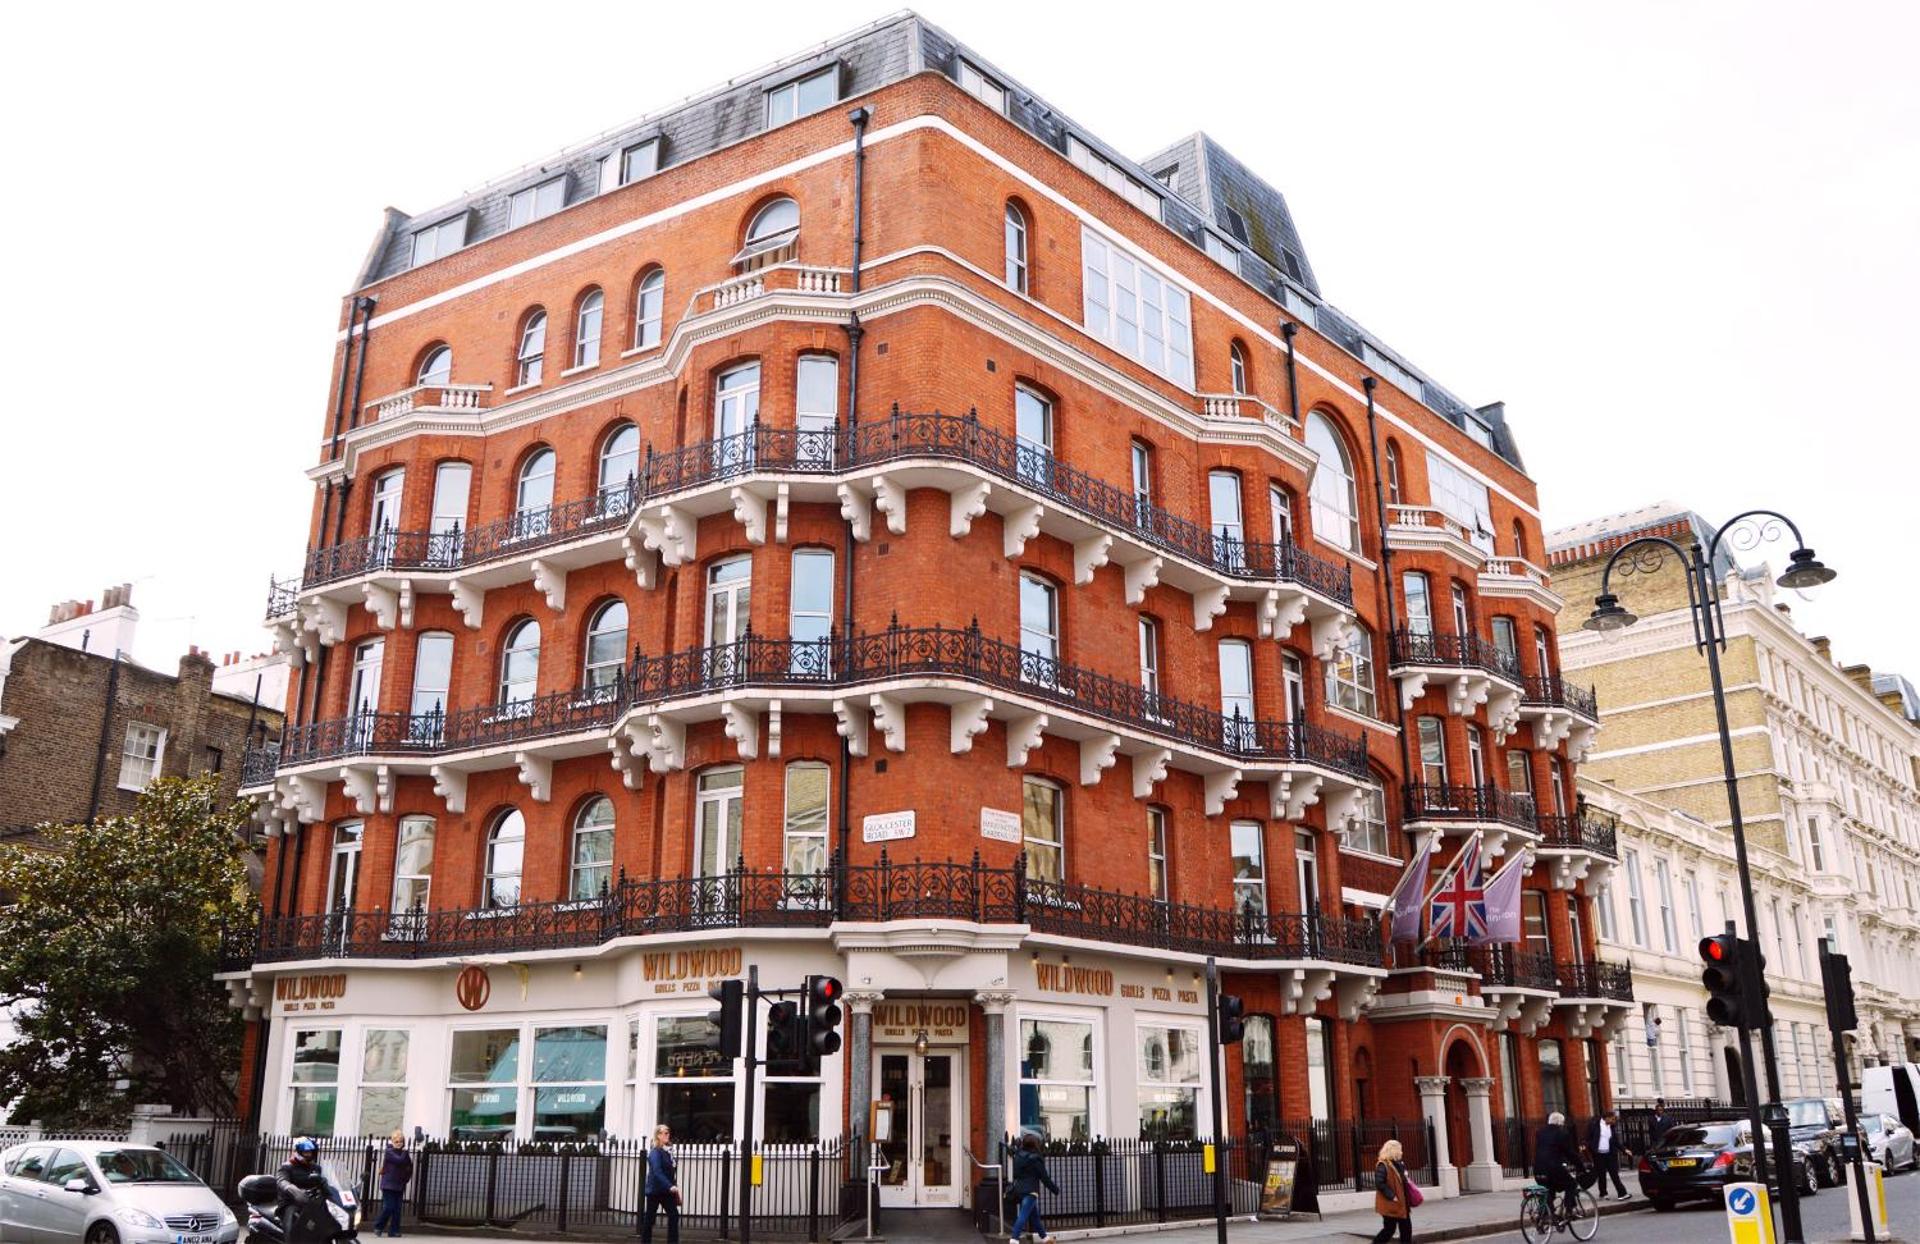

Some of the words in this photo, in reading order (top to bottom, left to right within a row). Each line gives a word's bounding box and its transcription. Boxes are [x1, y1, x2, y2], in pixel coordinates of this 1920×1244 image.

[865, 819, 913, 832] GLOUCESTER
[643, 948, 742, 981] WILDWOOD
[277, 974, 346, 1000] WILDWOOD
[655, 984, 676, 994] GRILLS
[683, 982, 701, 992] PIZZA
[1036, 963, 1114, 997] WILDWOOD
[1121, 984, 1145, 999] GRILLS
[1151, 987, 1171, 1002] PIZZA
[1178, 990, 1199, 1004] PASTA
[872, 1004, 966, 1027] WILDWOOD
[884, 1028, 905, 1036] GRILLS
[935, 1028, 953, 1036] PASTA
